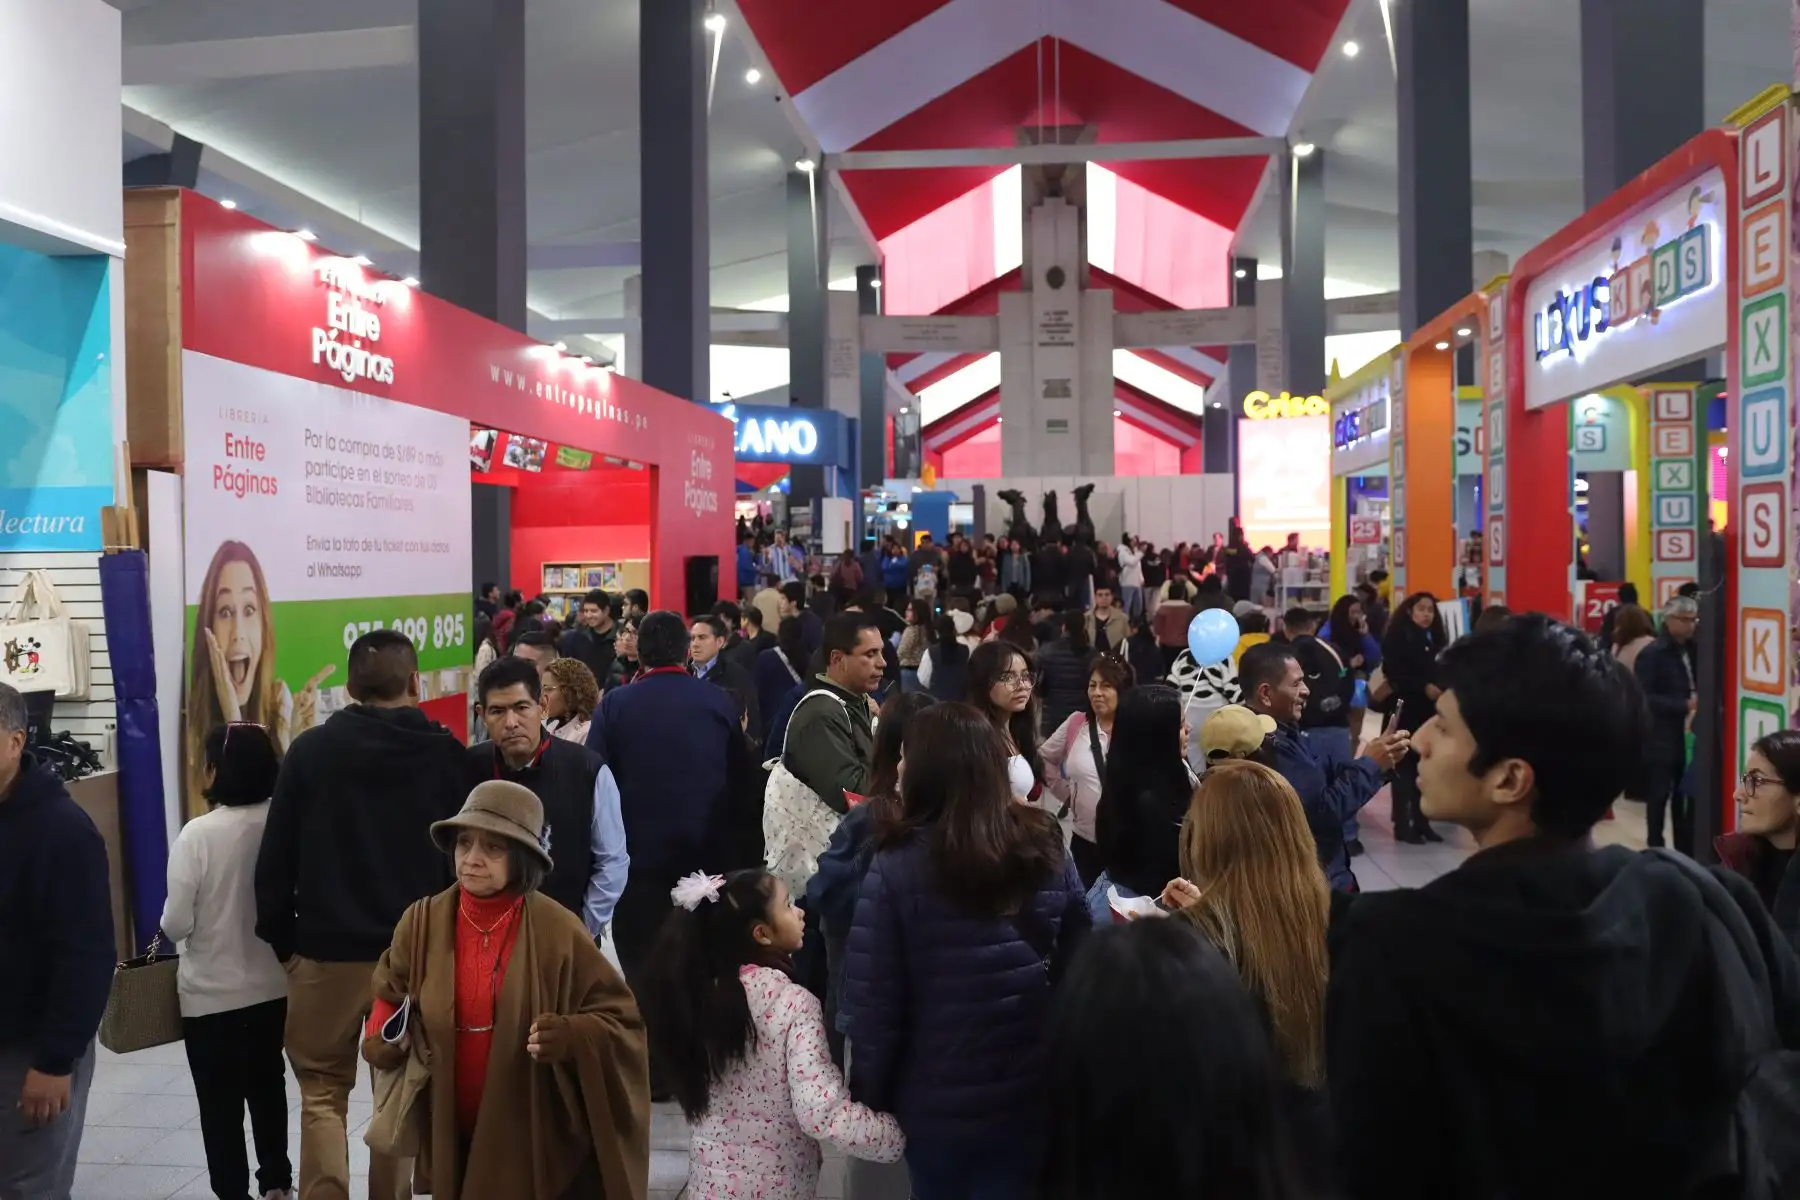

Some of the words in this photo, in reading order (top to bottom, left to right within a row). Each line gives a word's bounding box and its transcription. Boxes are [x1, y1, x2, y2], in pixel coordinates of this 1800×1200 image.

[327, 290, 381, 341] Entre
[312, 326, 395, 384] Páginas
[225, 431, 266, 462] Entre
[304, 427, 323, 449] Por
[326, 429, 337, 452] la
[338, 435, 380, 461] compra
[382, 441, 395, 460] de
[733, 416, 818, 455] ANO
[213, 463, 278, 500] Páginas
[357, 466, 371, 482] en
[373, 467, 382, 484] el
[305, 485, 365, 509] Bibliotecas
[0, 508, 85, 535] lectura
[332, 537, 342, 552] la
[361, 538, 372, 552] de
[306, 561, 316, 578] al
[317, 561, 363, 580] Whatsapp
[391, 616, 428, 652] 99
[432, 613, 465, 649] 895
